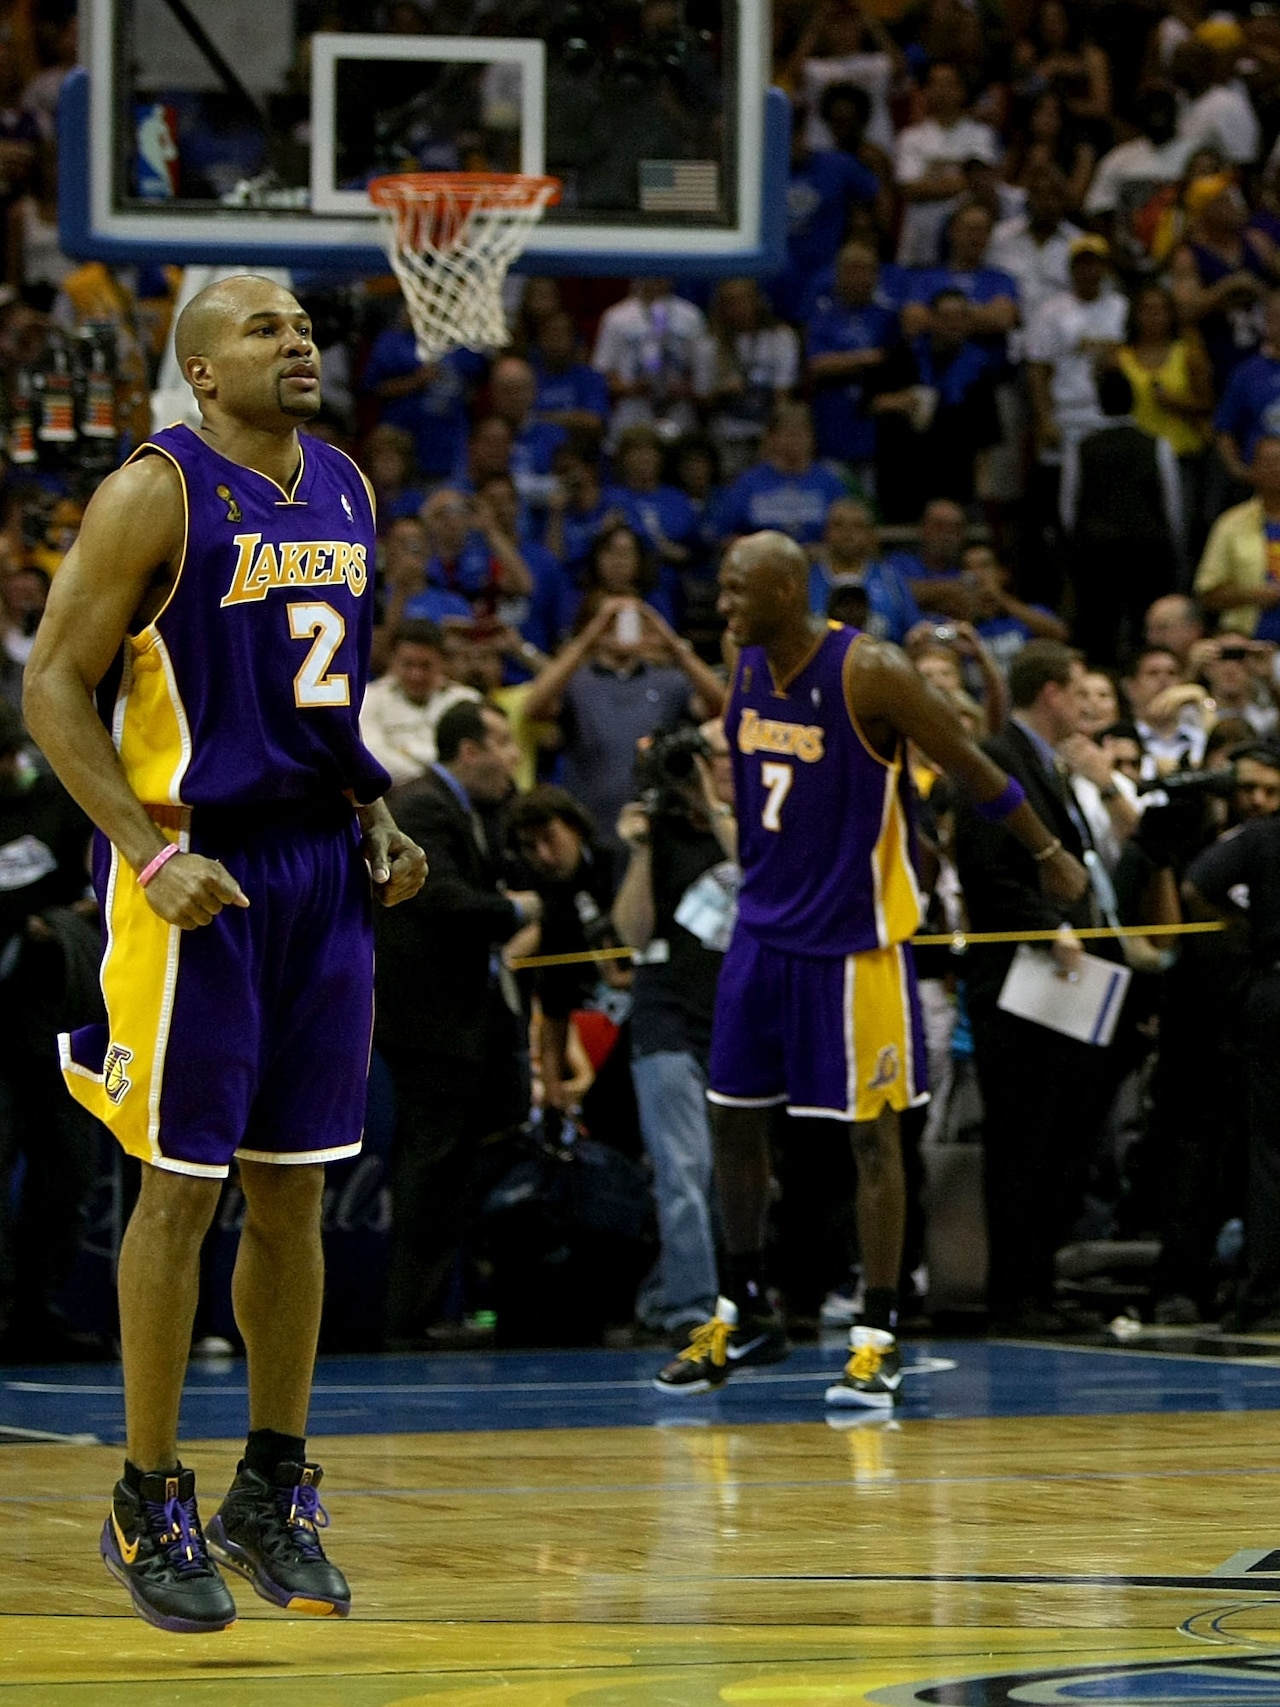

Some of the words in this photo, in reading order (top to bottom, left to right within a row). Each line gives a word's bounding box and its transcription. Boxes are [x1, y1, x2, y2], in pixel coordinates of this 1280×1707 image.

[220, 533, 367, 607] LAKERS
[286, 601, 350, 707] 2
[761, 761, 793, 831] 7
